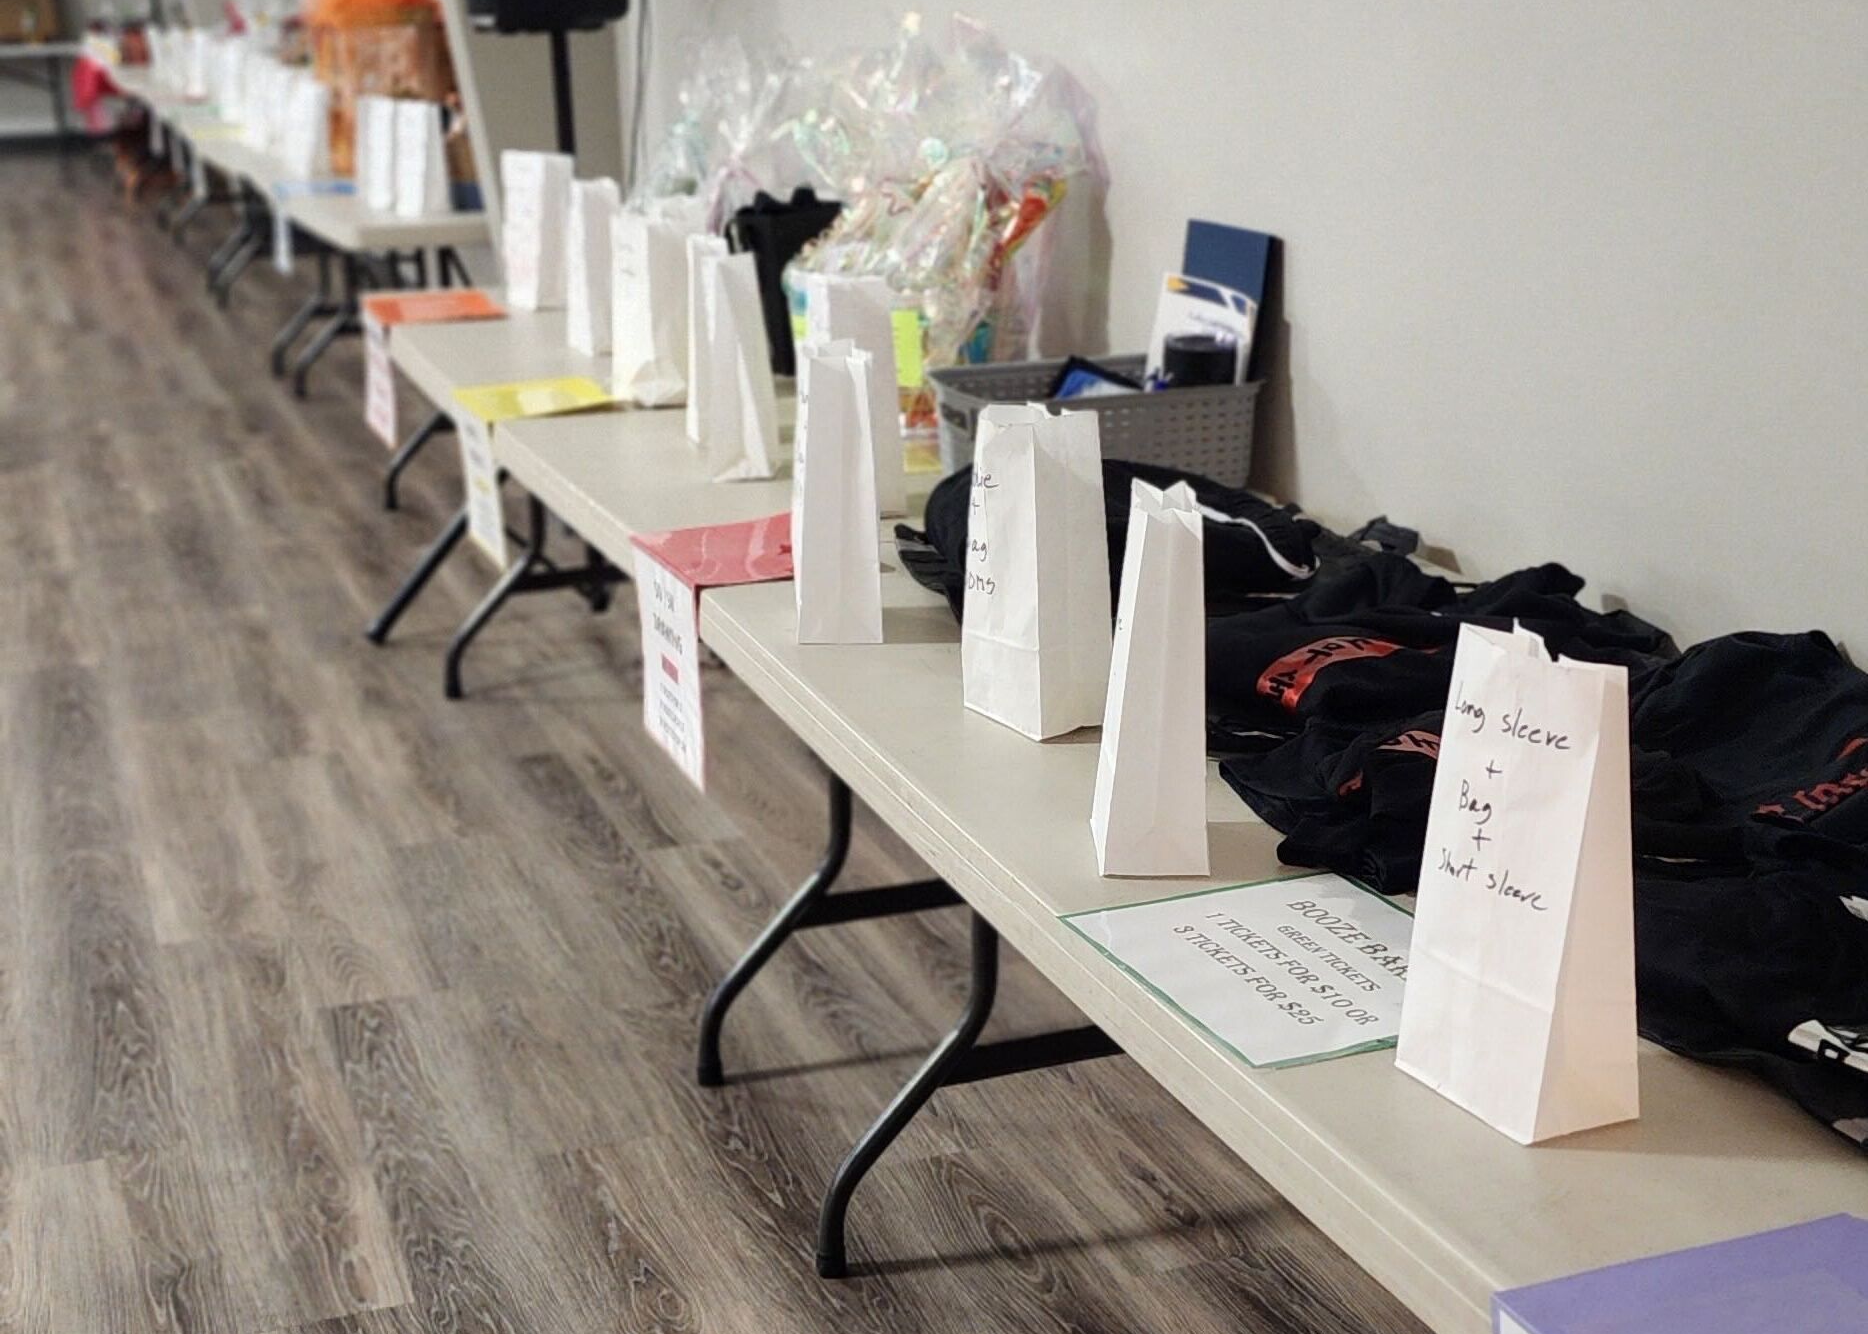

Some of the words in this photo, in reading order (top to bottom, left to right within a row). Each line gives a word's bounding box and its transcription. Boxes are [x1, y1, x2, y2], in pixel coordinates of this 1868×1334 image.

[1455, 681, 1486, 733] Long
[1501, 708, 1570, 750] sleeve
[1459, 779, 1493, 825] Bag
[1286, 900, 1372, 944] BOOZE
[1486, 870, 1548, 911] sleeve
[1185, 933, 1256, 976] TICKETS
[1244, 976, 1287, 1002] FOR
[1277, 1001, 1325, 1025] $25
[1217, 918, 1288, 960] TICKETS
[1276, 959, 1319, 984] FOR
[1310, 984, 1353, 1008] $10
[1345, 1009, 1379, 1026] OR
[1277, 925, 1327, 953] GREEN
[1320, 951, 1381, 992] TICKETS
